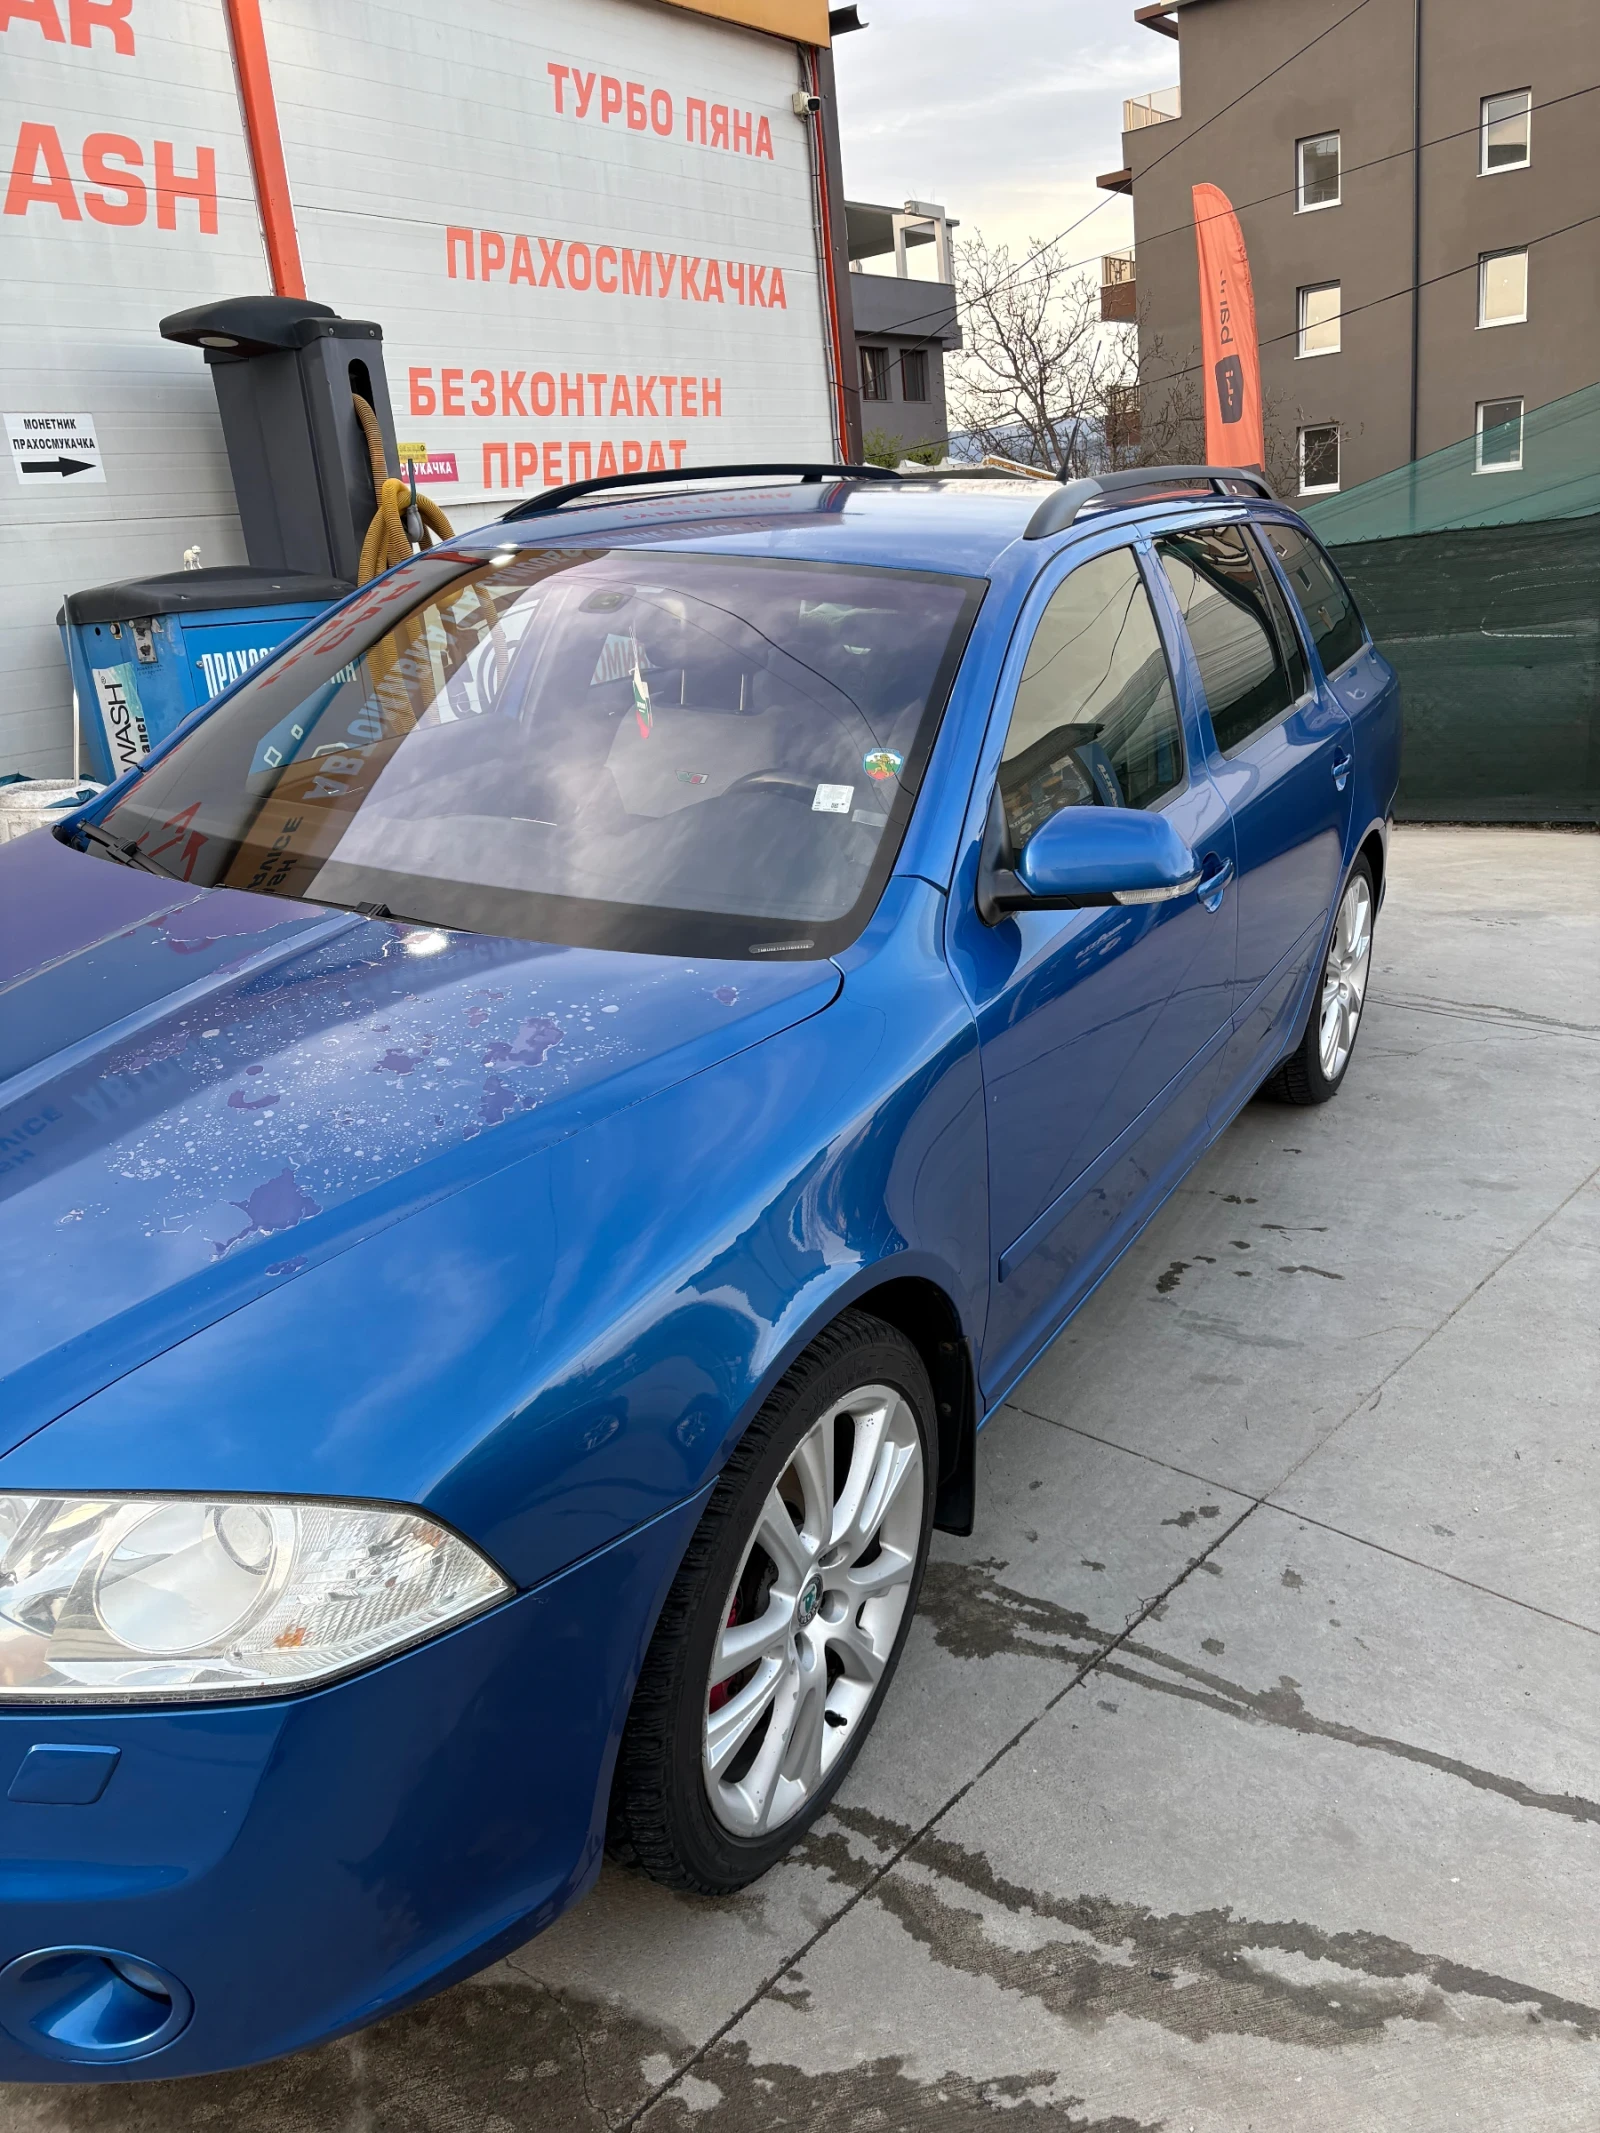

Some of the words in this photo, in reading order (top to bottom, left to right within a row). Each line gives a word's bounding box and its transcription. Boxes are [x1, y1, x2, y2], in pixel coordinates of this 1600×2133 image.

[547, 62, 673, 136] ТУРБО
[687, 97, 774, 160] ПЯНА
[4, 121, 218, 234] ASH
[447, 227, 787, 309] ПРАХОСМУКАЧКА
[409, 367, 722, 417] БЕЗКОНТАКТЕН
[12, 438, 96, 450] ПРАХОСМУКАЧКА
[23, 418, 77, 430] МОНЕТНИК
[400, 461, 453, 476] СУКАЧКА
[482, 440, 687, 489] ПРЕПАРАТ
